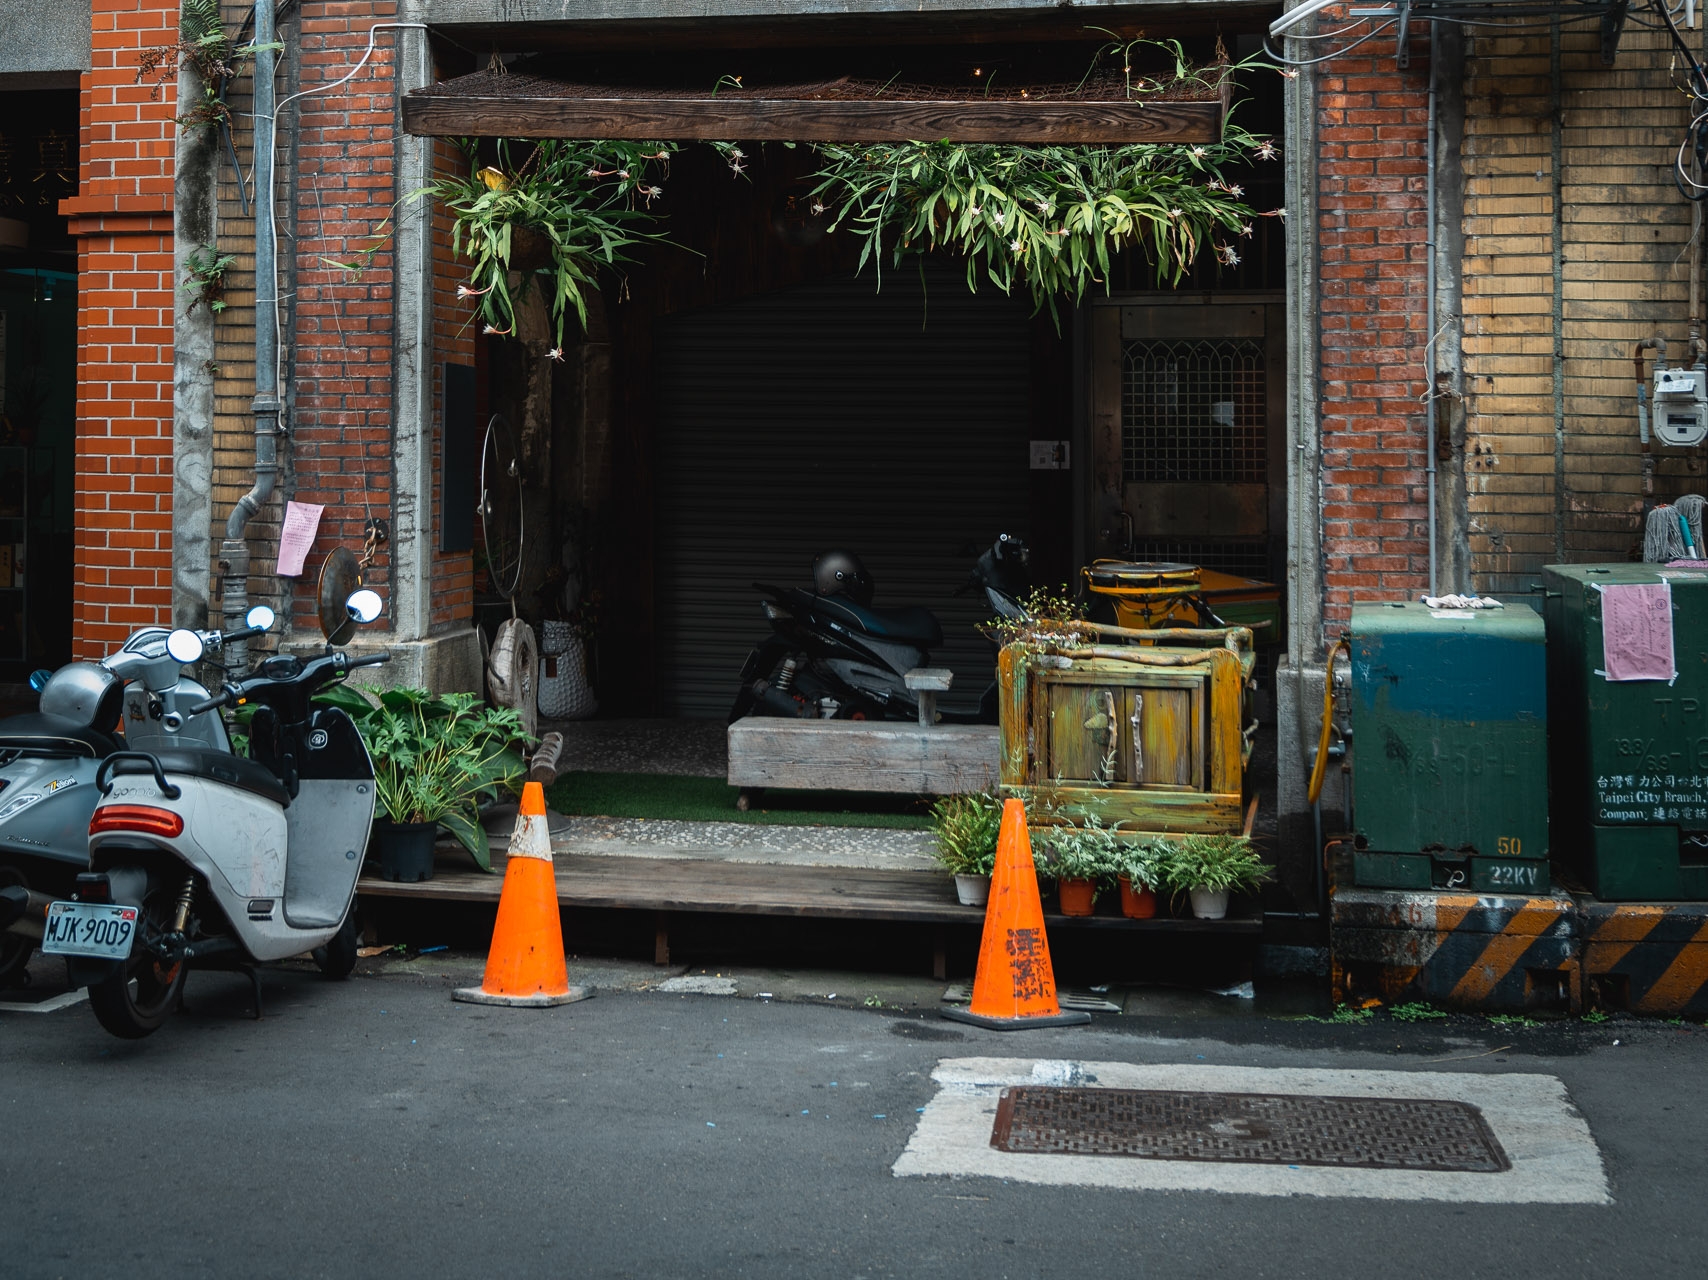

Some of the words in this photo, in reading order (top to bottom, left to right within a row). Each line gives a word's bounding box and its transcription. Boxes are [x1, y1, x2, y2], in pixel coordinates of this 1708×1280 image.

[1598, 791, 1634, 804] Taipei
[1636, 791, 1661, 803] City
[1497, 837, 1521, 855] 50
[1489, 866, 1538, 885] 22KV
